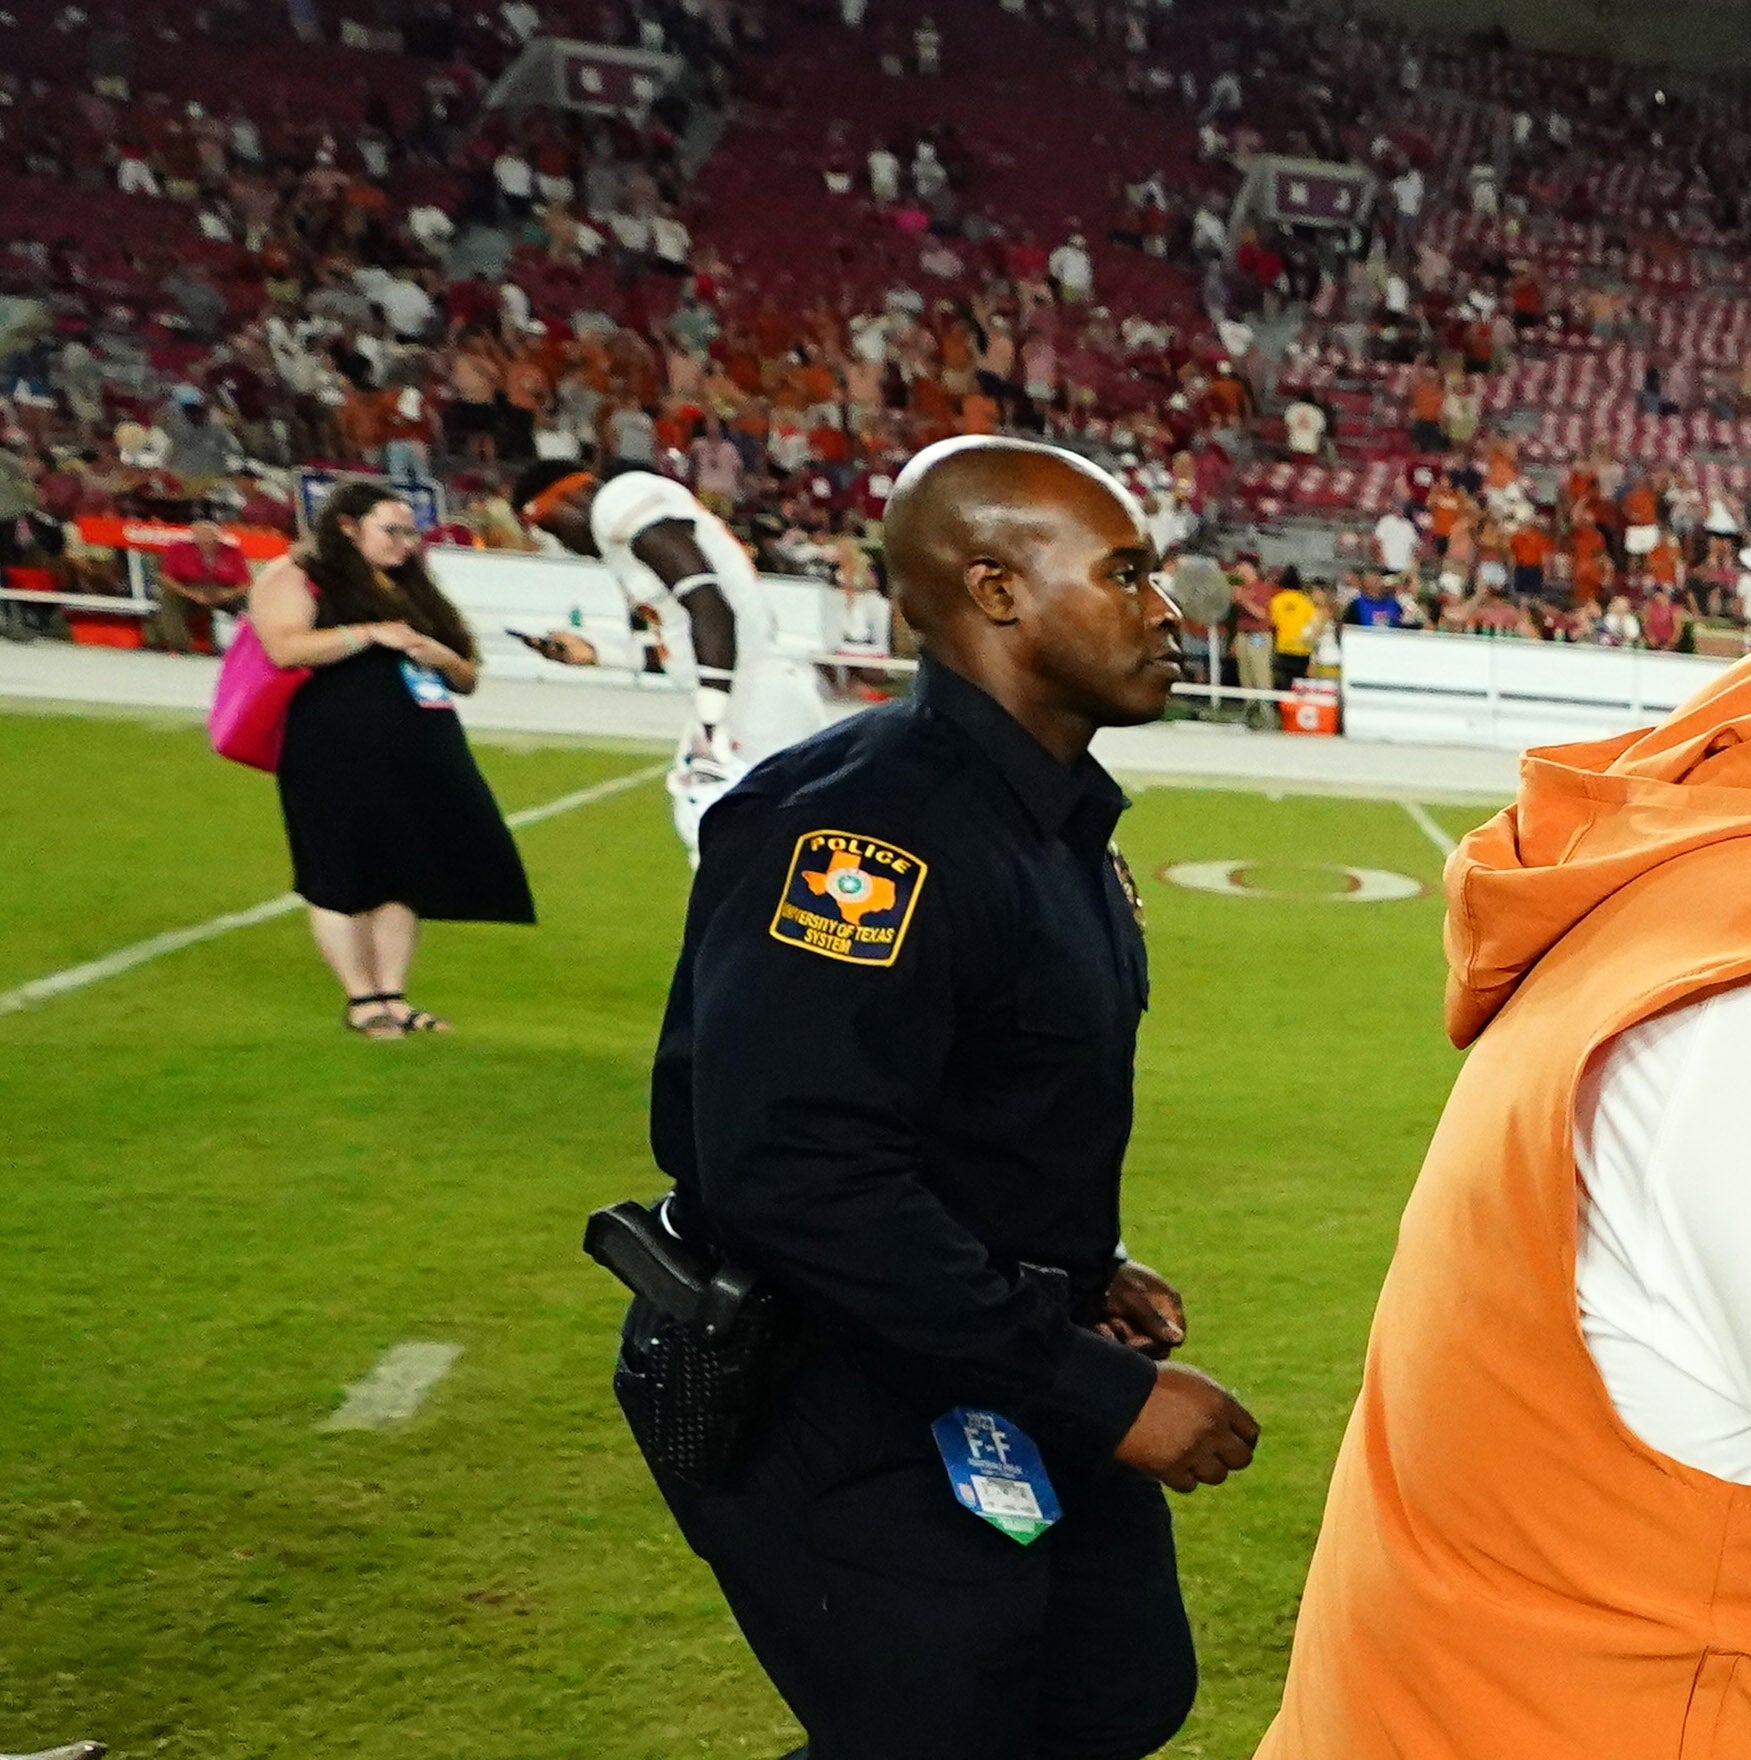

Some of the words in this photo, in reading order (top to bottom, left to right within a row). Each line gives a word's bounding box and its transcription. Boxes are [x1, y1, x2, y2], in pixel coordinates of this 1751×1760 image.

[810, 836, 912, 875] POLICE
[804, 928, 852, 954] SYSTEM
[836, 924, 855, 938] OF
[854, 926, 896, 944] TEXAS
